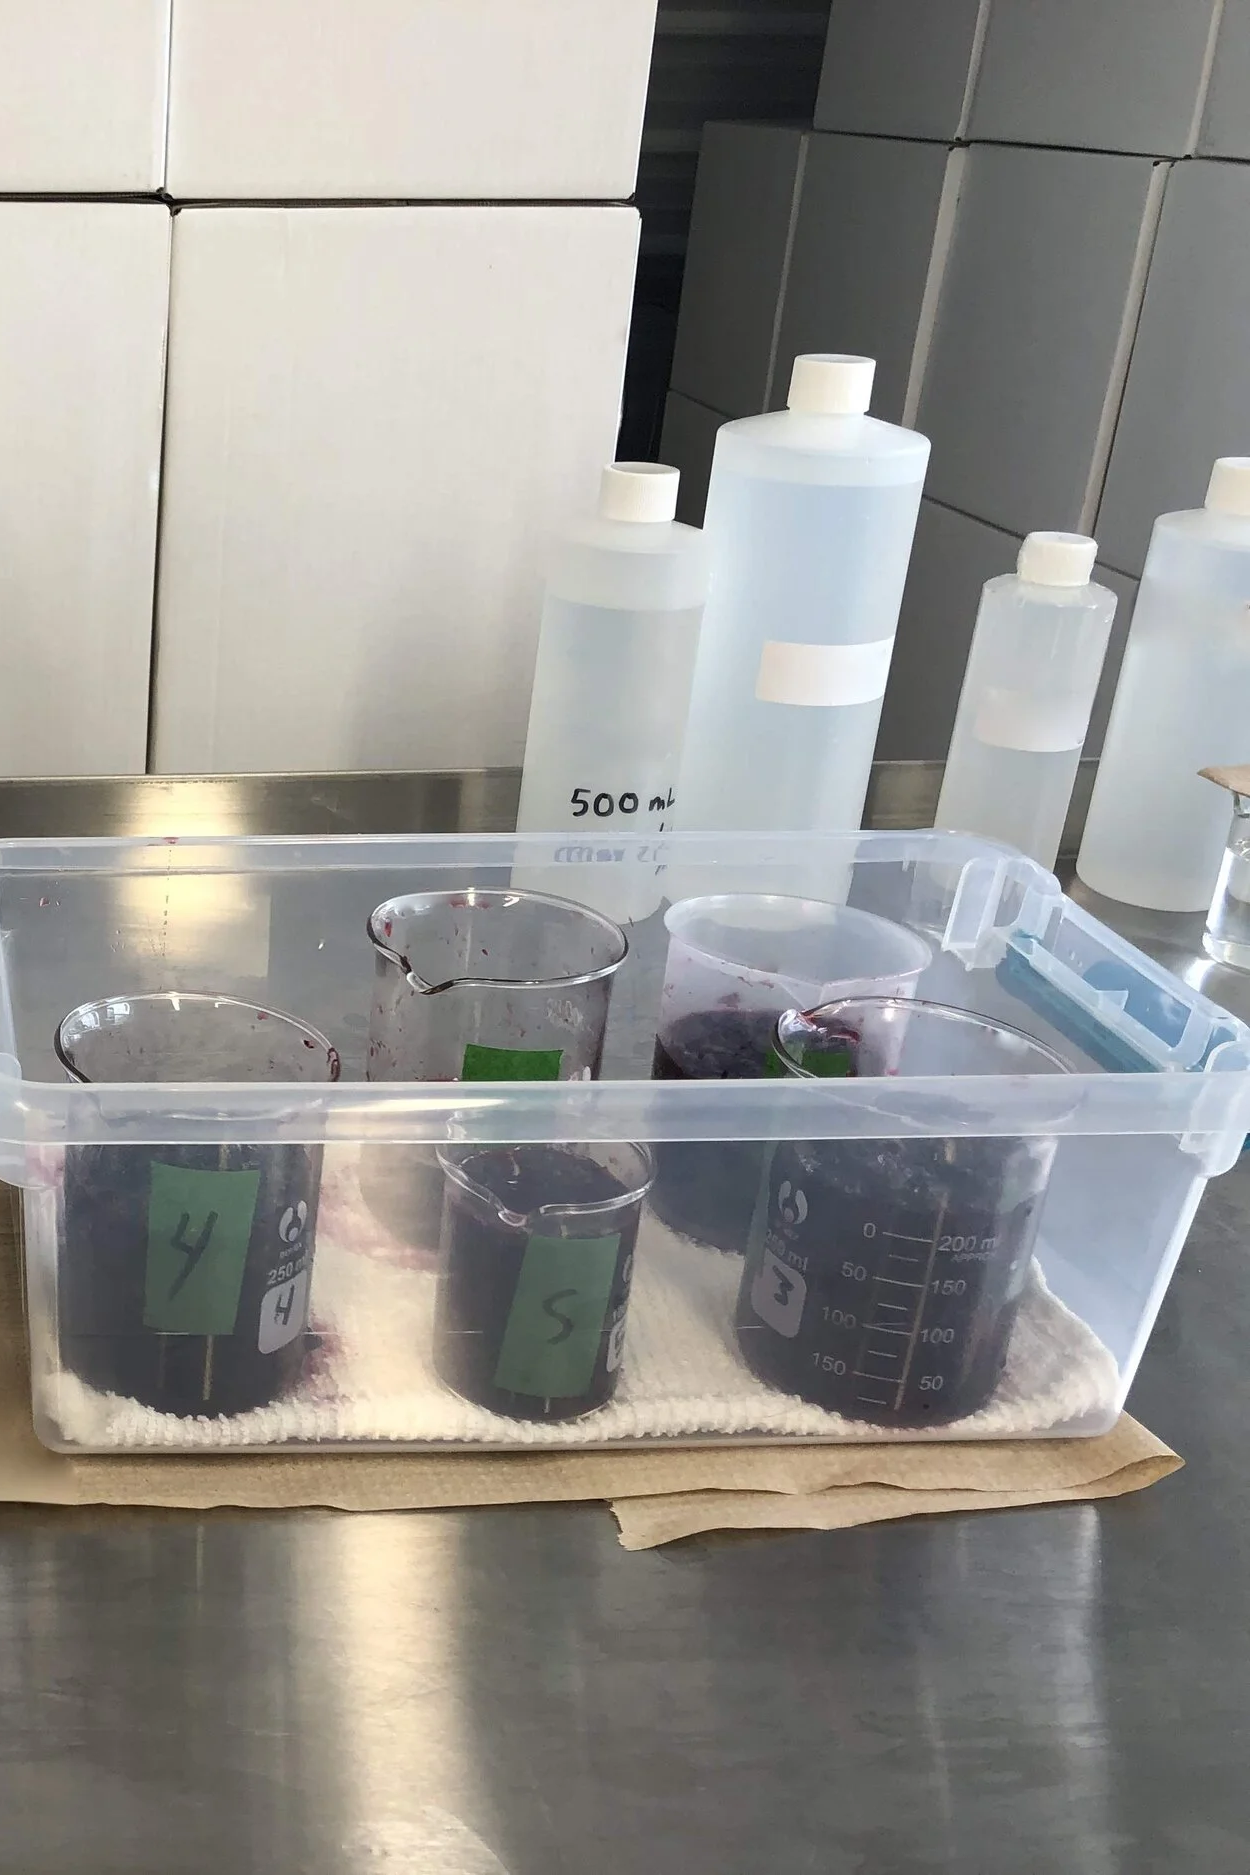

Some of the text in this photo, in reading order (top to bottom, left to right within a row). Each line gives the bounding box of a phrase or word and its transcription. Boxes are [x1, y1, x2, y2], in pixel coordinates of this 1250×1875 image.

[570, 788, 639, 817] 500
[937, 1235, 977, 1251] 200
[267, 1261, 293, 1285] 250
[841, 1261, 867, 1281] 50
[931, 1280, 967, 1295] 150
[822, 1306, 857, 1330] 100
[920, 1328, 955, 1344] 100
[812, 1352, 846, 1376] 150
[919, 1375, 944, 1391] 50
